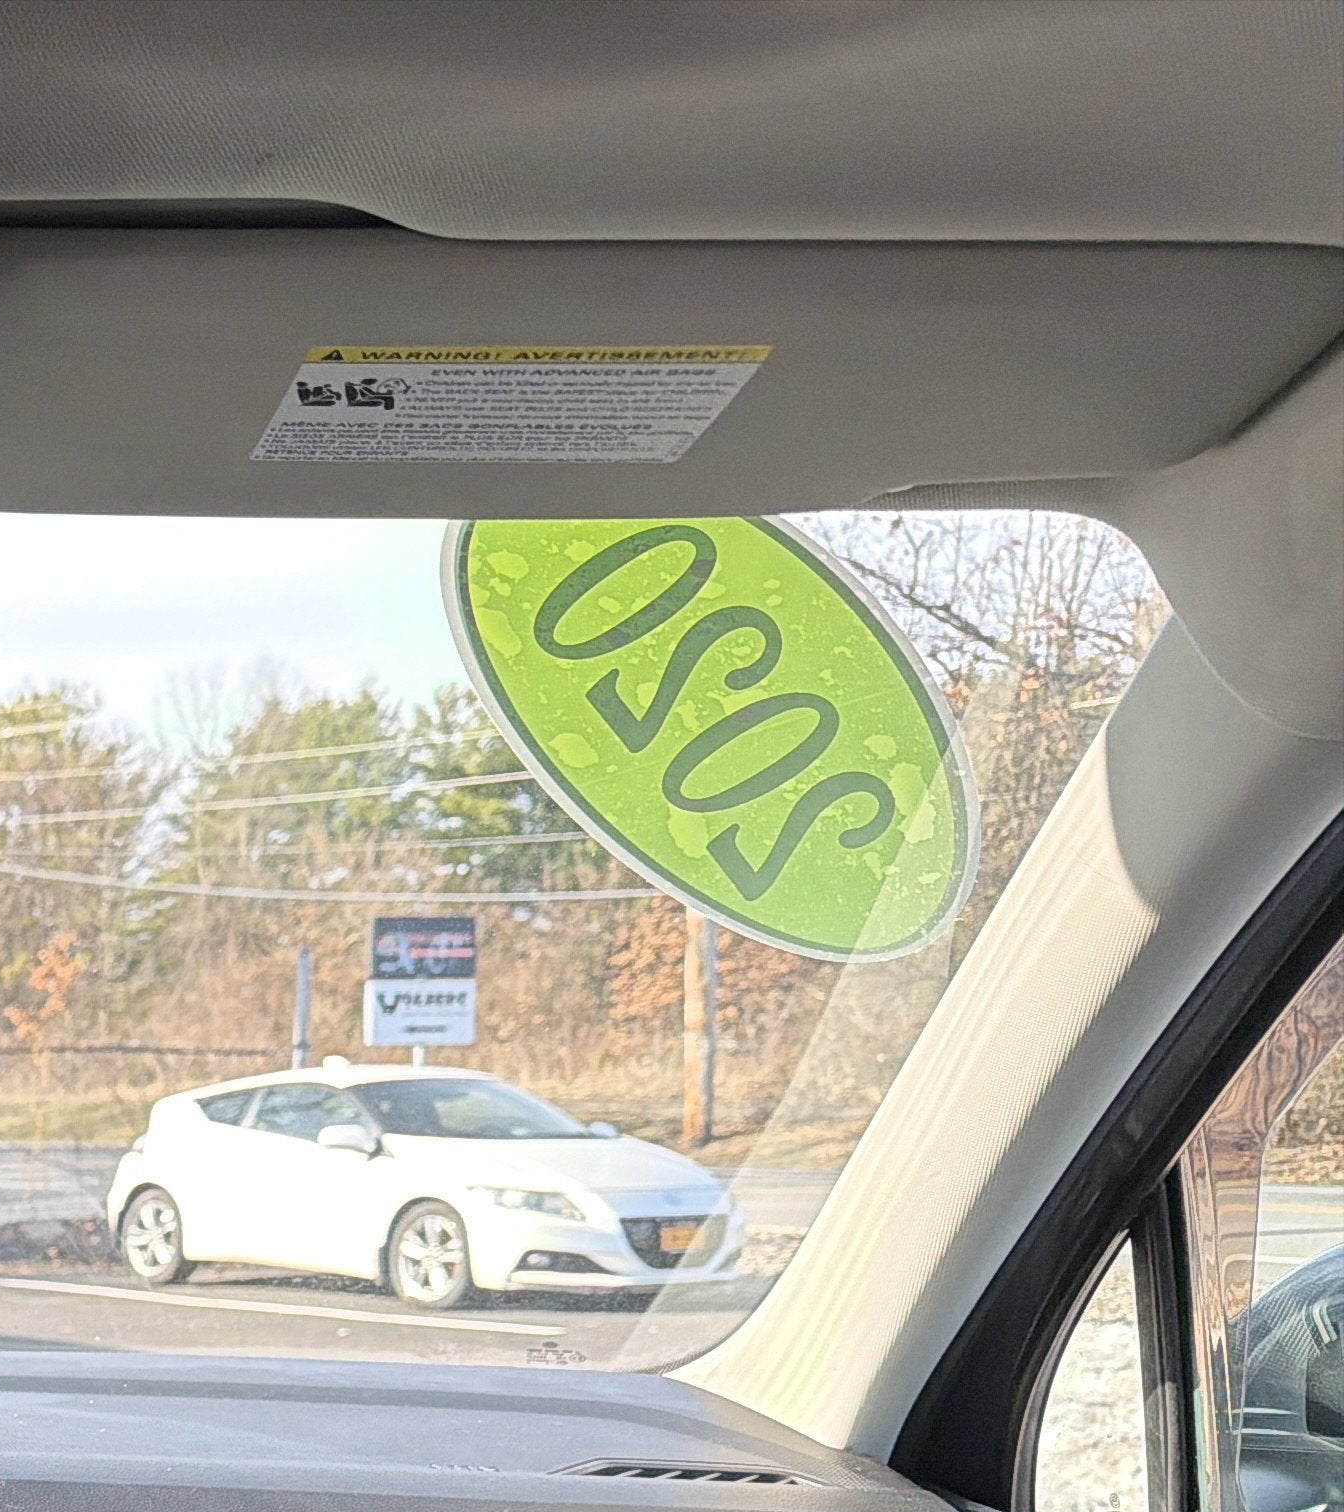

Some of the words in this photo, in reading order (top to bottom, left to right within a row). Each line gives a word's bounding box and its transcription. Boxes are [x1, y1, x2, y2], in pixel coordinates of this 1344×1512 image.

[362, 351, 501, 361] WARNING!
[513, 350, 748, 361] AVERTISSEMENT!
[431, 368, 477, 376] EVEN
[483, 368, 527, 376] WITH
